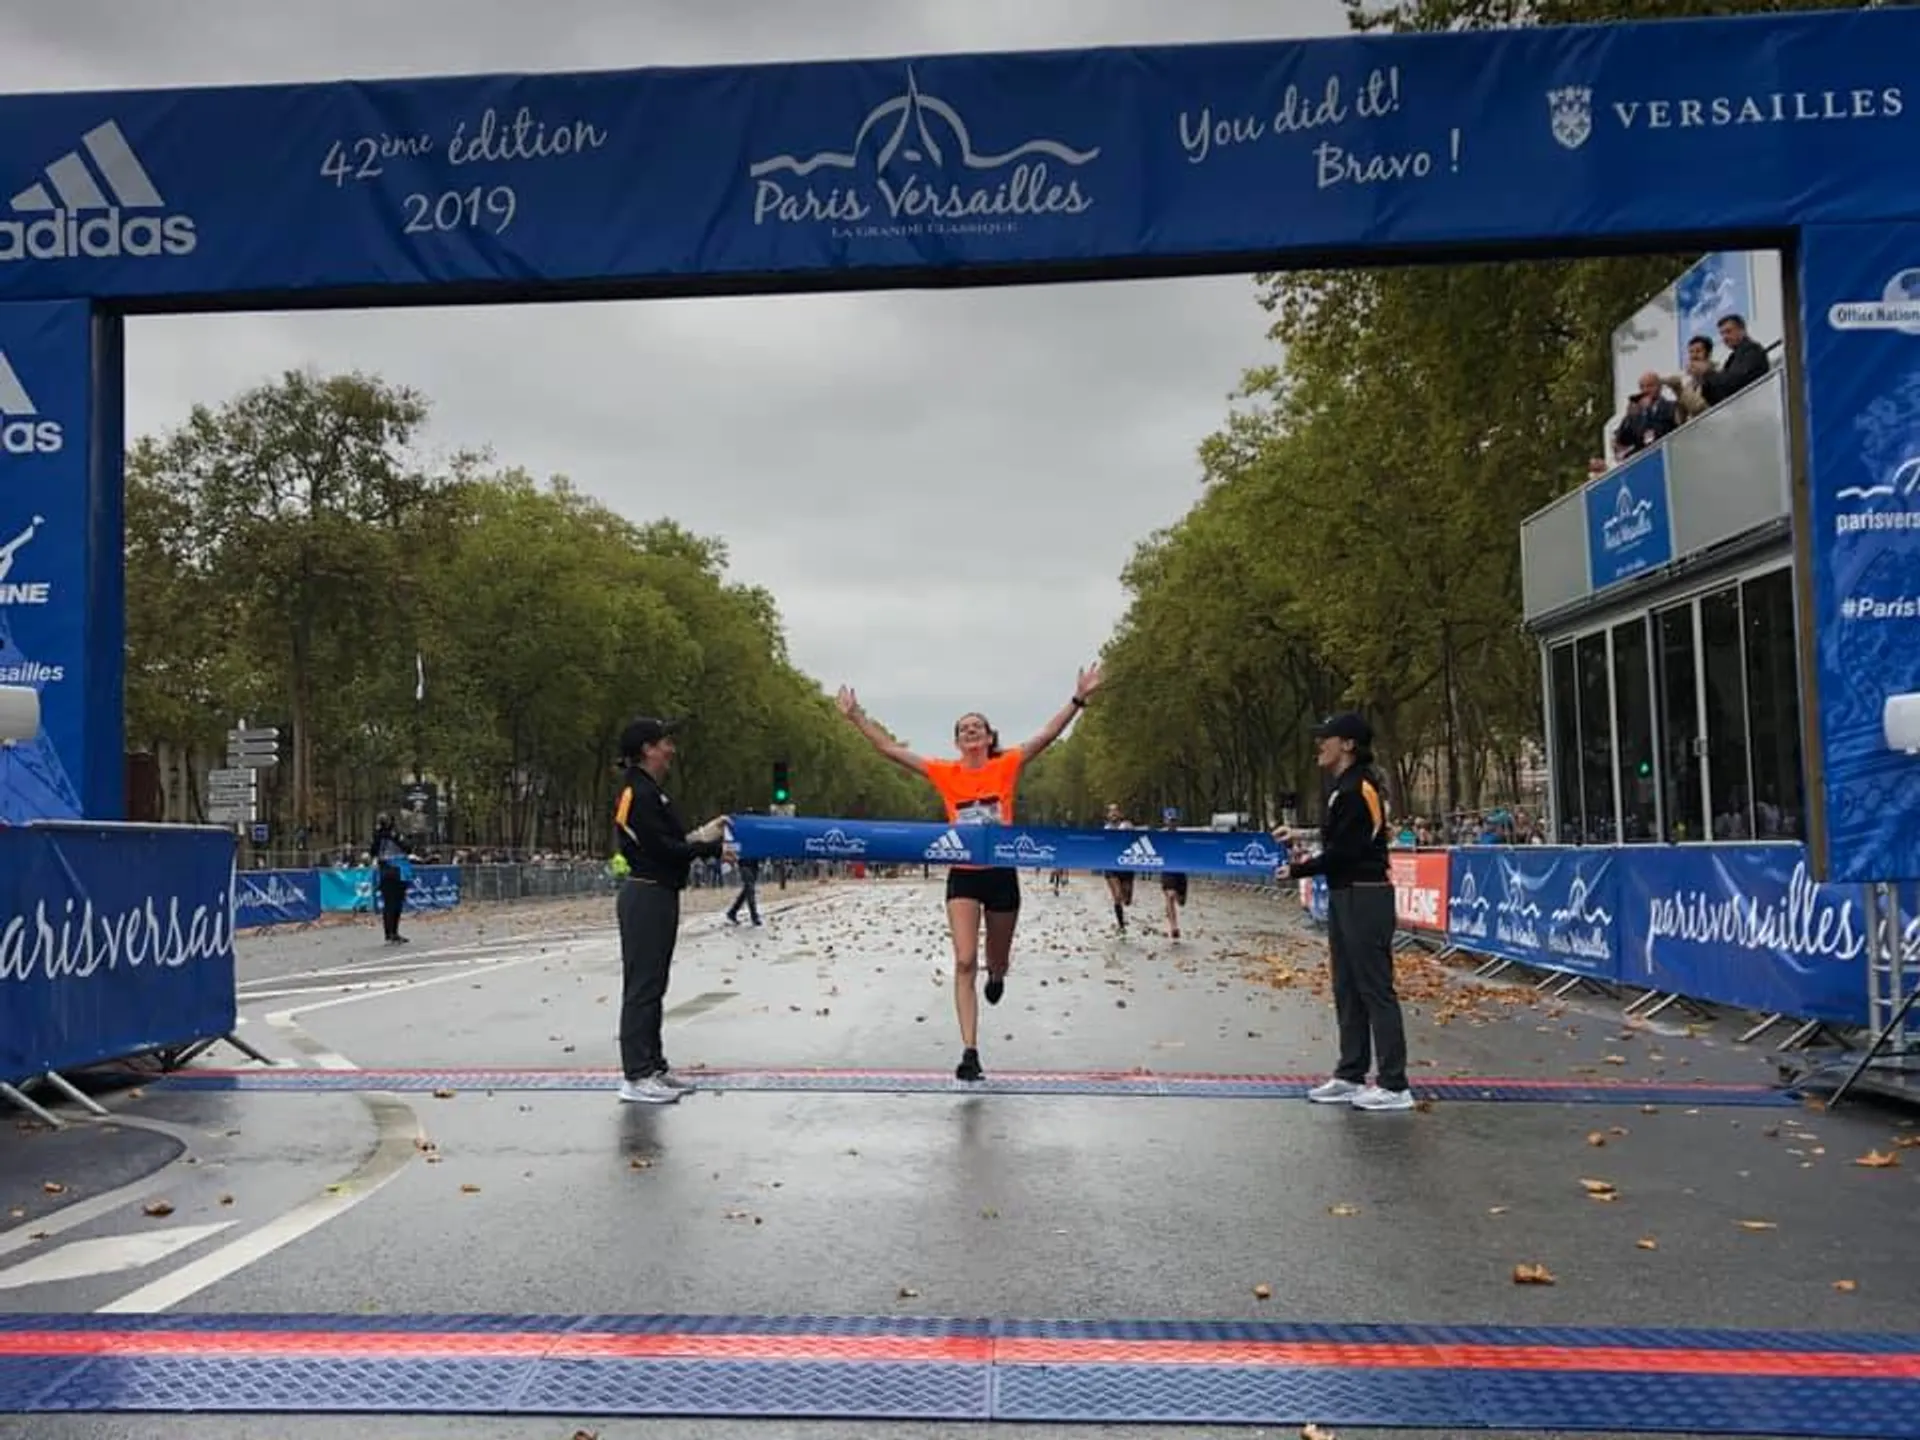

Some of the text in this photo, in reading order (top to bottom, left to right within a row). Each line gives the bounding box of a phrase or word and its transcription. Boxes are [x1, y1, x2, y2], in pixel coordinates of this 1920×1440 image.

[1179, 66, 1400, 164] You did it!
[1612, 88, 1904, 129] VERSAILLES
[320, 106, 608, 188] 42ème édition
[1312, 140, 1431, 188] Bravo
[403, 185, 517, 234] 2019
[753, 162, 1095, 226] Paris Versailles
[0, 206, 197, 261] adidas
